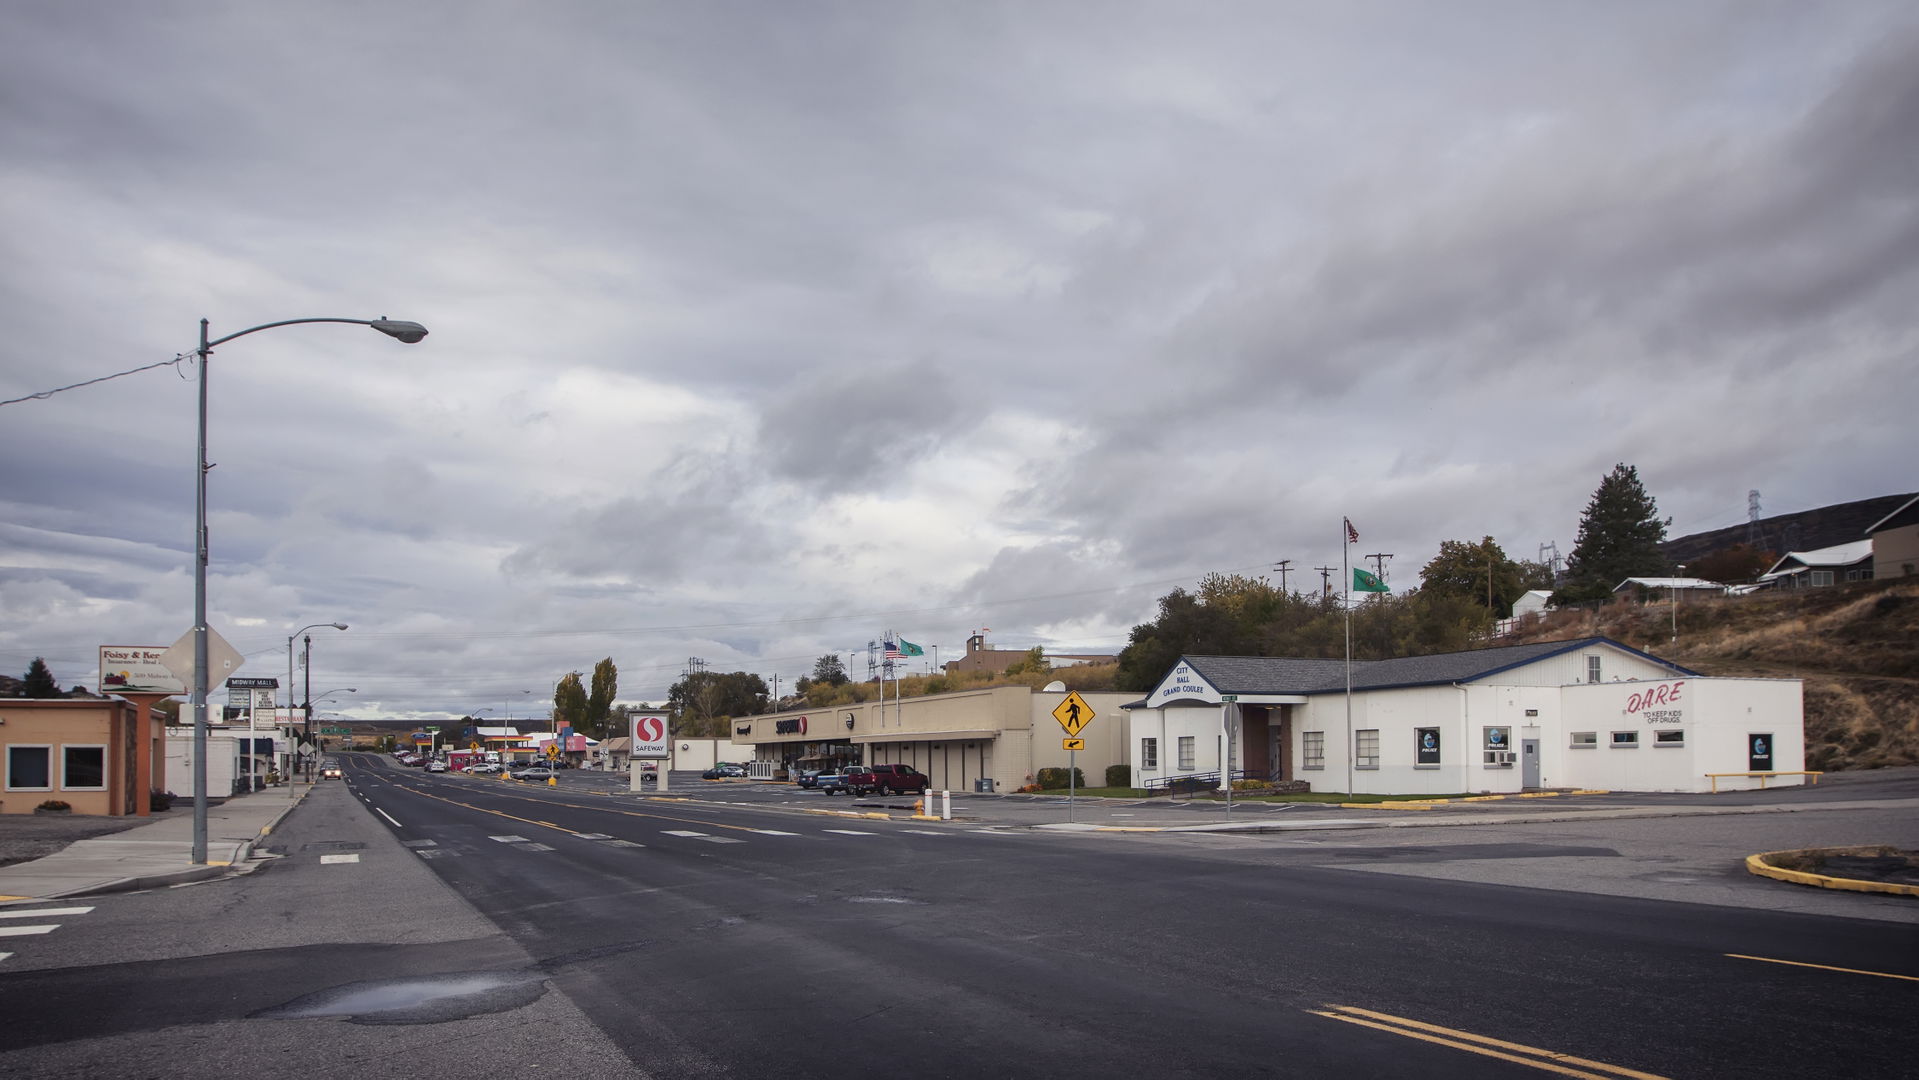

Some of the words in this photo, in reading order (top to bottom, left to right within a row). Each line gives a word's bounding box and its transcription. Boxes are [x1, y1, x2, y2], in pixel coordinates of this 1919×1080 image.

[103, 651, 129, 659] Foisy
[131, 651, 141, 659] &
[143, 651, 160, 659] Ker
[1176, 676, 1189, 684] HALL
[1163, 686, 1181, 697] GRAND
[1182, 685, 1204, 694] COULEE
